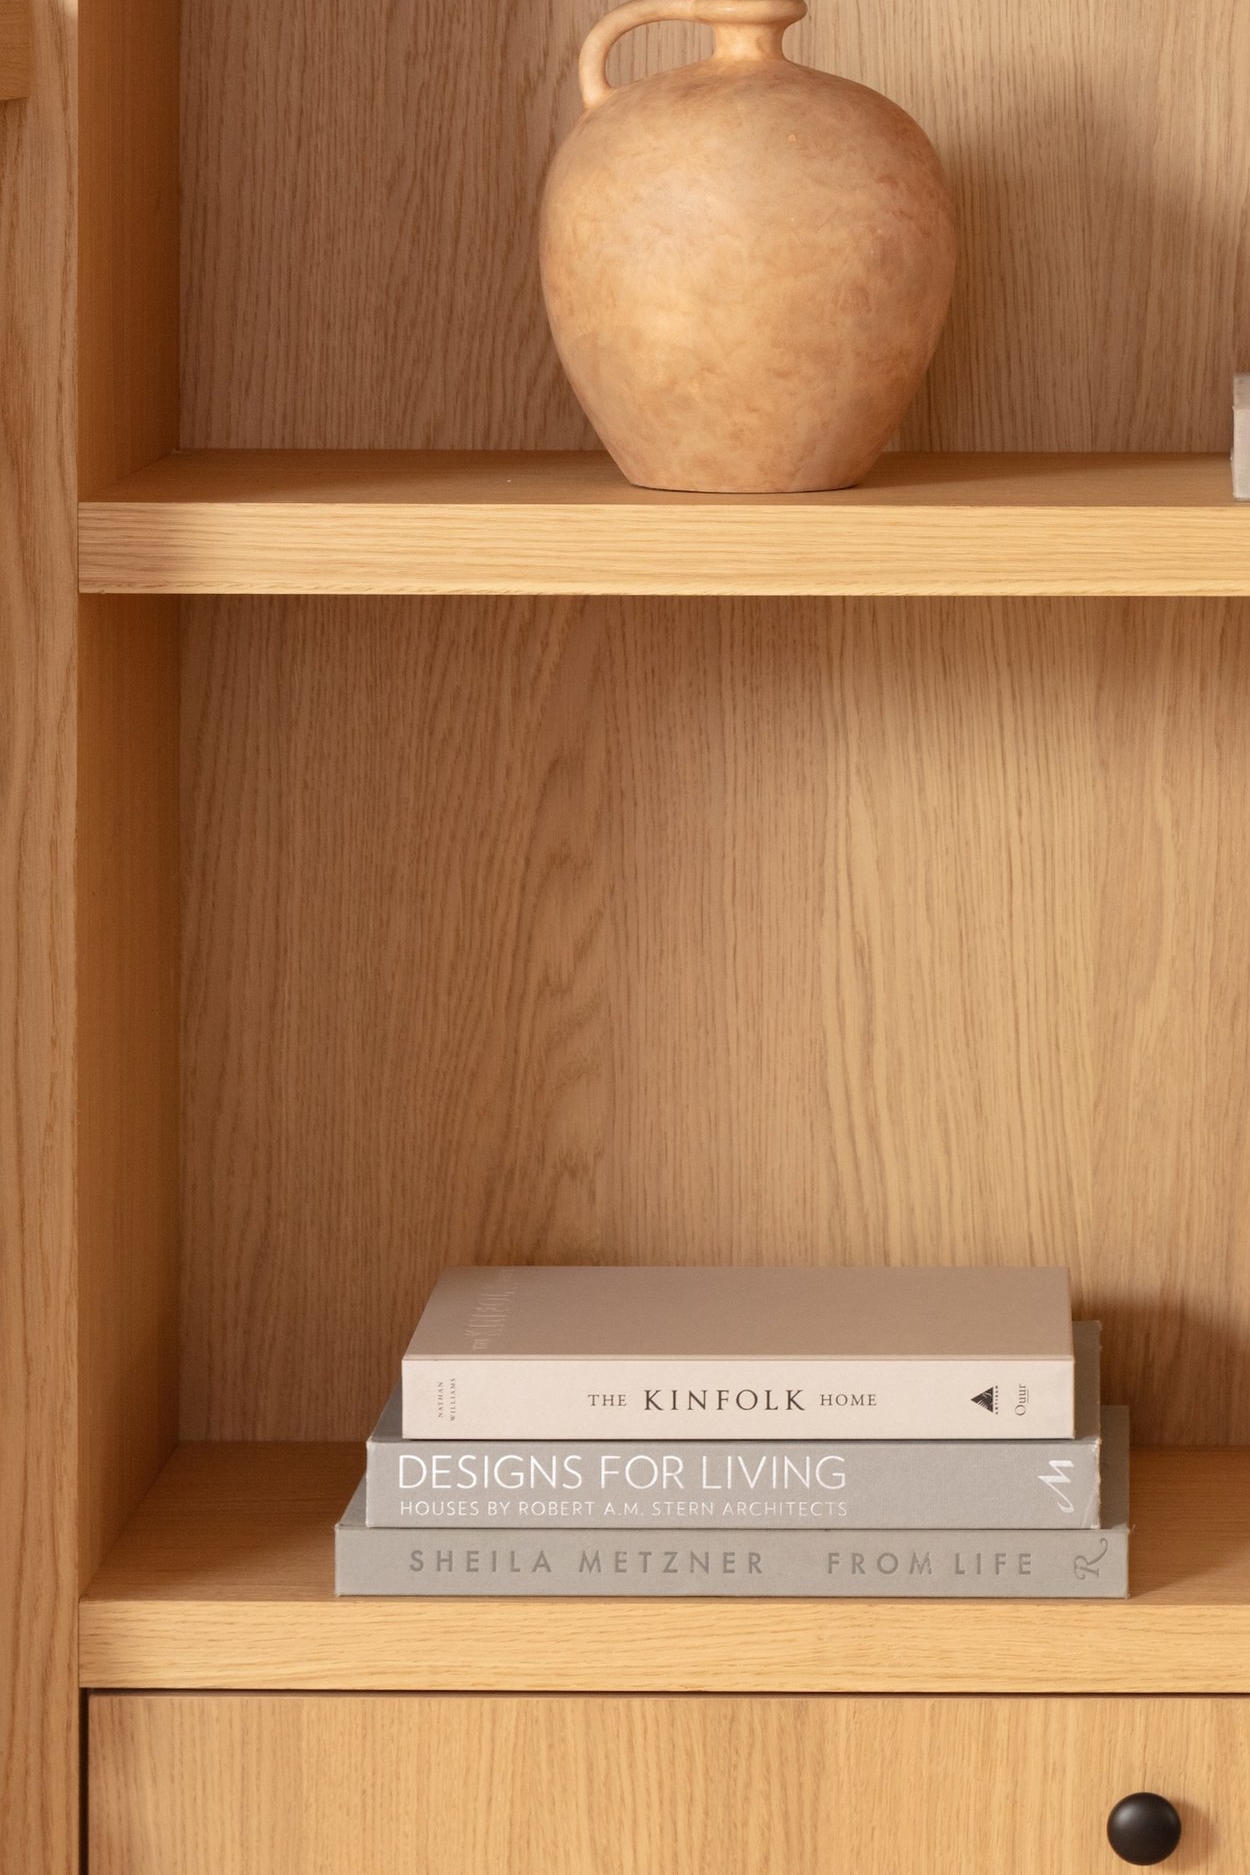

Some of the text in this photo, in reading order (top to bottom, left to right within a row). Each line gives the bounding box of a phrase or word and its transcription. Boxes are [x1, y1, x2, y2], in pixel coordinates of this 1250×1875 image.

[587, 1389, 877, 1411] THE KINFOLK HOME
[1014, 1383, 1026, 1416] Ouur
[399, 1454, 846, 1490] DESIGNS FOR LIVING
[400, 1501, 847, 1517] HOUSES BY ROBERT A.M. STERN ARCHITECTS
[409, 1549, 1032, 1576] SHEILA METZNER FROM LIFE
